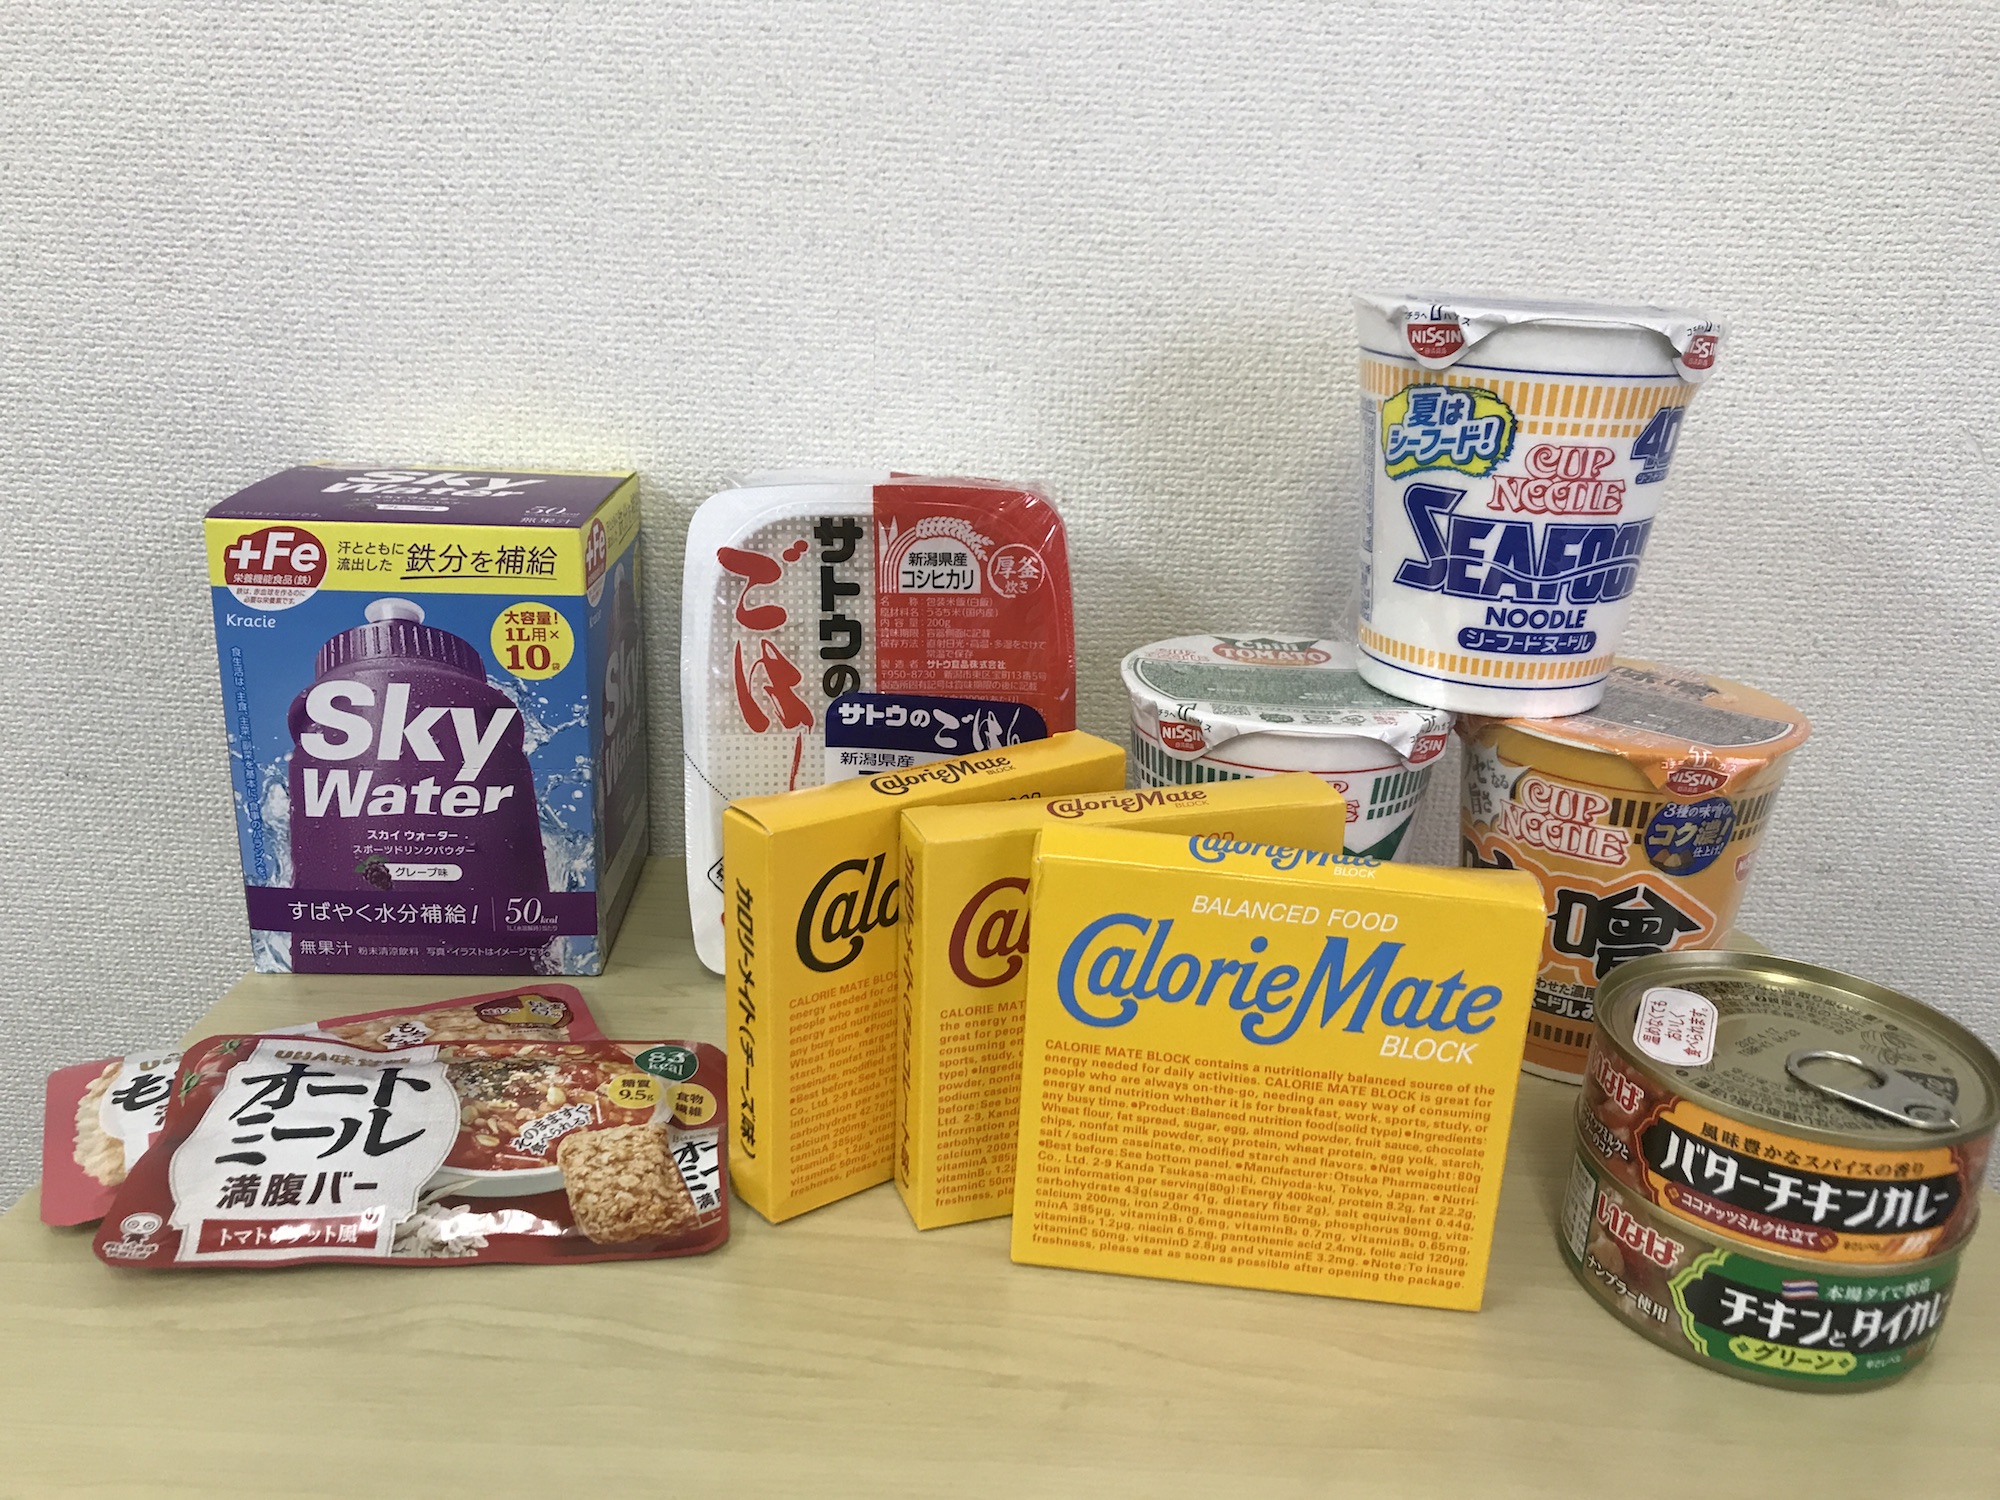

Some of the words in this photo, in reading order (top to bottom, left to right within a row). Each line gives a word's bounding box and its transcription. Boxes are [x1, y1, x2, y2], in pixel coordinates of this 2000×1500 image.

[1411, 326, 1462, 347] NISSIN
[1407, 391, 1465, 427] 夏は
[1388, 421, 1495, 456] シーフード!
[1524, 443, 1615, 481] CUP
[229, 531, 320, 573] +Fe
[337, 541, 405, 555] 汗とともに
[1393, 482, 1656, 605] SEAFOO
[336, 557, 392, 572] 流出した
[406, 543, 558, 576] 鉄分を補給
[908, 552, 968, 568] 新潟県産
[994, 556, 1041, 580] 厚釜
[233, 573, 312, 586] 栄養機能食品(鉄)
[902, 569, 974, 590] コシヒカリ
[1005, 580, 1029, 594] 炊き
[226, 613, 277, 629] Kracie
[503, 610, 559, 625] 大容量!
[813, 517, 864, 698] サトウの
[1485, 606, 1587, 629] NOODLE
[927, 618, 951, 628] 200g
[1465, 629, 1592, 652] シーフードヌードル
[300, 680, 518, 782] Sky
[840, 752, 915, 768] 新潟県産
[870, 756, 1012, 796] CalorieMate
[303, 768, 515, 818] Water
[1046, 788, 1207, 819] CalorieMate
[1522, 779, 1610, 823] CUP
[367, 830, 400, 841] スカイ
[404, 830, 458, 841] ウォーター
[352, 845, 476, 856] スポーツドリンクパウダー
[394, 867, 449, 878] グレープ味
[1333, 866, 1376, 879] BLOCK
[288, 901, 480, 925] すばやく水分補給!
[1191, 895, 1321, 926] BALANCED
[1327, 907, 1399, 933] FOOD
[299, 940, 353, 956] 無果汁
[1057, 912, 1503, 1046] CalorieMate
[789, 989, 837, 1008] CALORIE
[839, 980, 870, 995] MATE
[789, 1004, 826, 1022] energy
[829, 991, 867, 1010] needed
[736, 878, 757, 1160] カロリーメイト(チーズ味)
[939, 1020, 960, 1032] the
[965, 1015, 1007, 1029] energy
[940, 1003, 995, 1020] CALORIE
[998, 1000, 1025, 1013] MAT
[939, 1032, 970, 1045] great
[974, 1029, 991, 1039] for
[939, 1040, 1006, 1056] consuming
[1379, 1035, 1479, 1065] BLOCK
[1043, 1054, 1088, 1068] energy
[1090, 1059, 1139, 1072] needed
[1141, 1062, 1161, 1074] for
[1162, 1066, 1195, 1080] daily
[1197, 1071, 1260, 1085] activities.
[1264, 1076, 1324, 1091] CALORIE
[1326, 1082, 1367, 1096] MATE
[1369, 1087, 1417, 1100] BLOCK
[1419, 1092, 1431, 1102] is
[1434, 1096, 1470, 1106] great
[1473, 1097, 1493, 1107] for
[1044, 1039, 1102, 1055] CALORIE
[1104, 1046, 1143, 1059] MATE
[1145, 1050, 1191, 1065] BLOCK
[1193, 1058, 1249, 1071] contains
[1251, 1064, 1261, 1072] a
[1263, 1066, 1344, 1082] nutritionally
[1346, 1072, 1407, 1087] balanced
[1409, 1081, 1454, 1091] source
[1456, 1083, 1471, 1093] of
[1473, 1084, 1496, 1095] the
[229, 1063, 431, 1121] オート
[621, 1078, 651, 1088] 糖質
[676, 1091, 704, 1104] 食物
[215, 1107, 426, 1167] ミール
[513, 1103, 592, 1151] そのまますぐ
[1701, 1121, 1925, 1178] 風味豊かなスパイスの香り
[216, 1171, 378, 1209] 満腹バー
[1659, 1130, 1950, 1230] バターチキンカレー
[1595, 1190, 1684, 1269] いなば
[1681, 1192, 1818, 1246] ココナッツミルク仕立て
[219, 1223, 358, 1247] トマトット風
[1587, 1254, 1669, 1323] ナンプラー使用
[1754, 1345, 1835, 1370] グリーン
